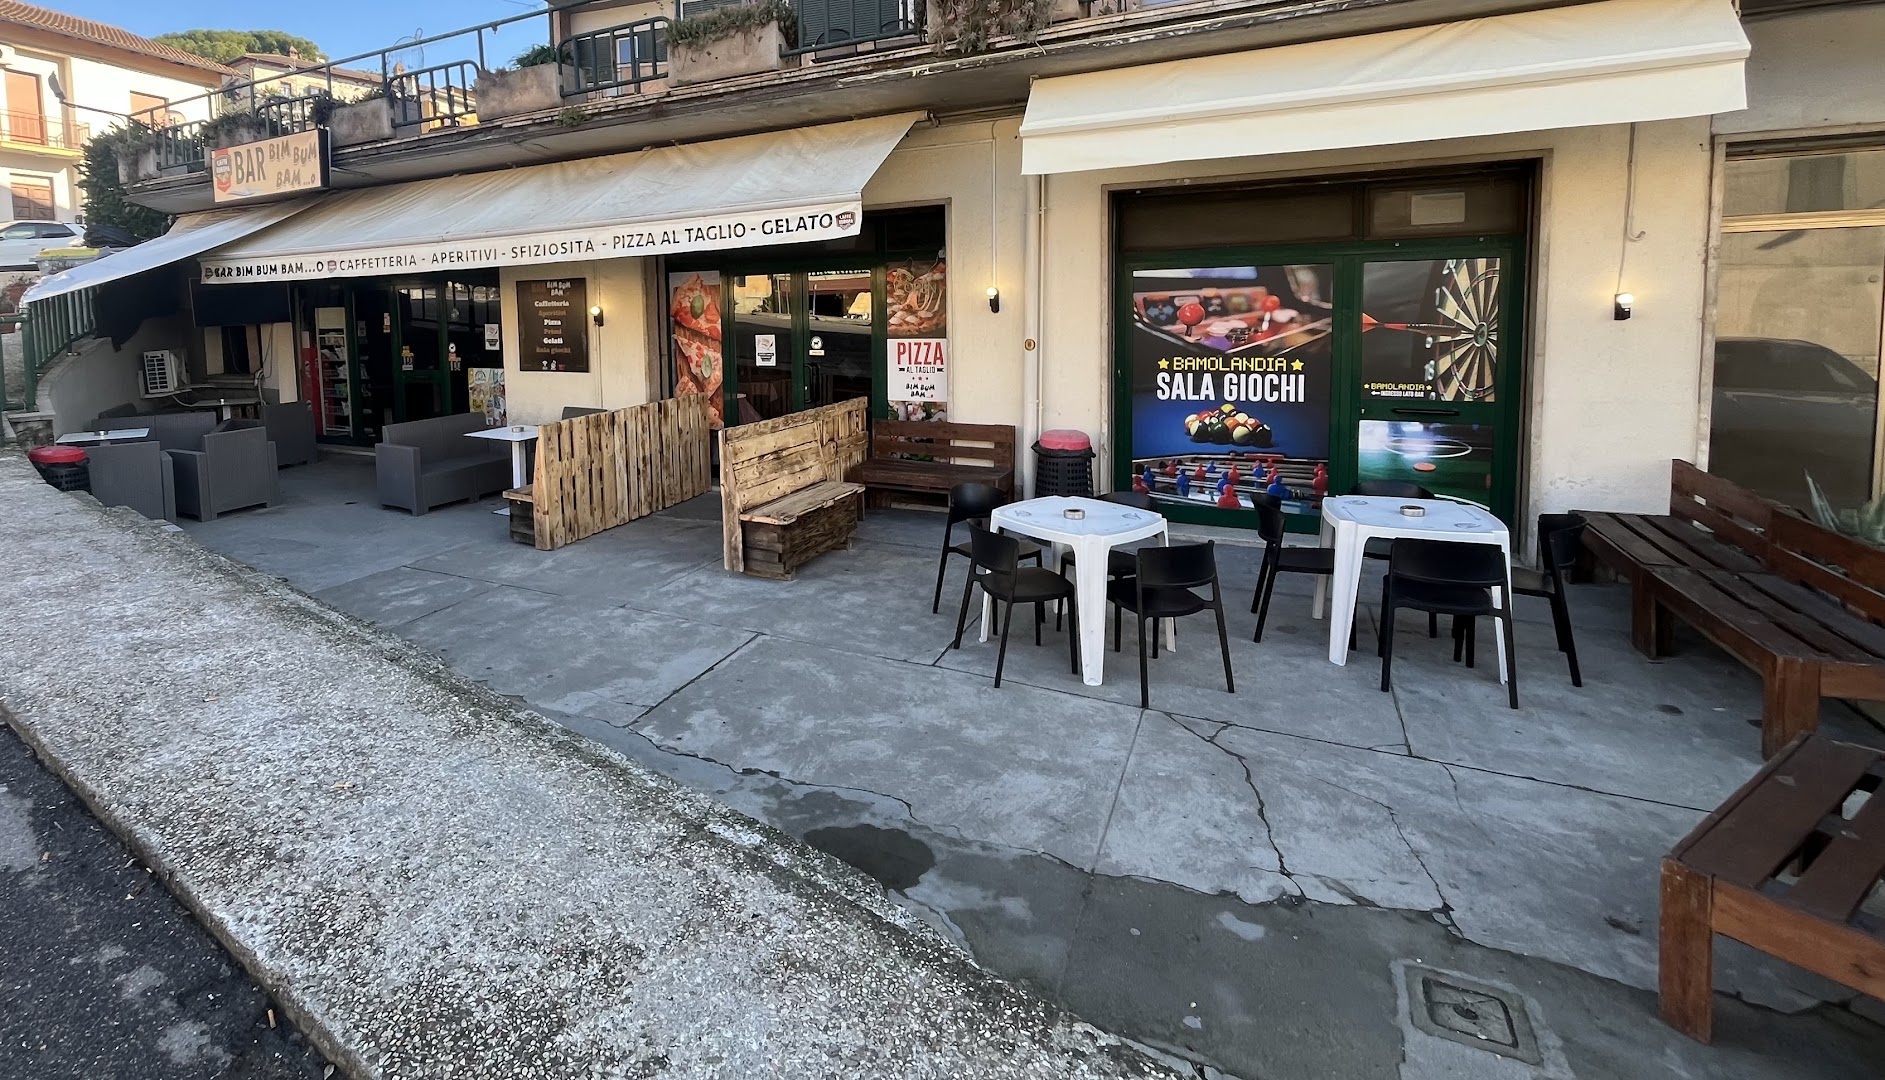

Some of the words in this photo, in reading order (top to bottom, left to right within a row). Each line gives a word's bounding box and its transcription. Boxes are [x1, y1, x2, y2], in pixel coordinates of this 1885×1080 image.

[234, 147, 266, 184] BAR
[269, 140, 291, 162] BIM
[293, 142, 317, 166] BUM
[215, 267, 233, 278] BAR
[236, 265, 253, 277] BIM
[257, 264, 277, 276] BUM
[339, 255, 417, 271] CAFFETTERIA
[431, 249, 497, 264] APERITIVI
[613, 233, 655, 250] PIZZA
[660, 230, 680, 245] AL
[684, 222, 746, 243] TAGLIO
[761, 213, 833, 236] GELATO
[897, 342, 944, 365] PIZZA
[1173, 357, 1287, 371] BAMOLANDIA
[1156, 372, 1215, 401] SALA
[1223, 372, 1305, 403] GIOCHI
[1371, 382, 1426, 391] BAMOLANDIA
